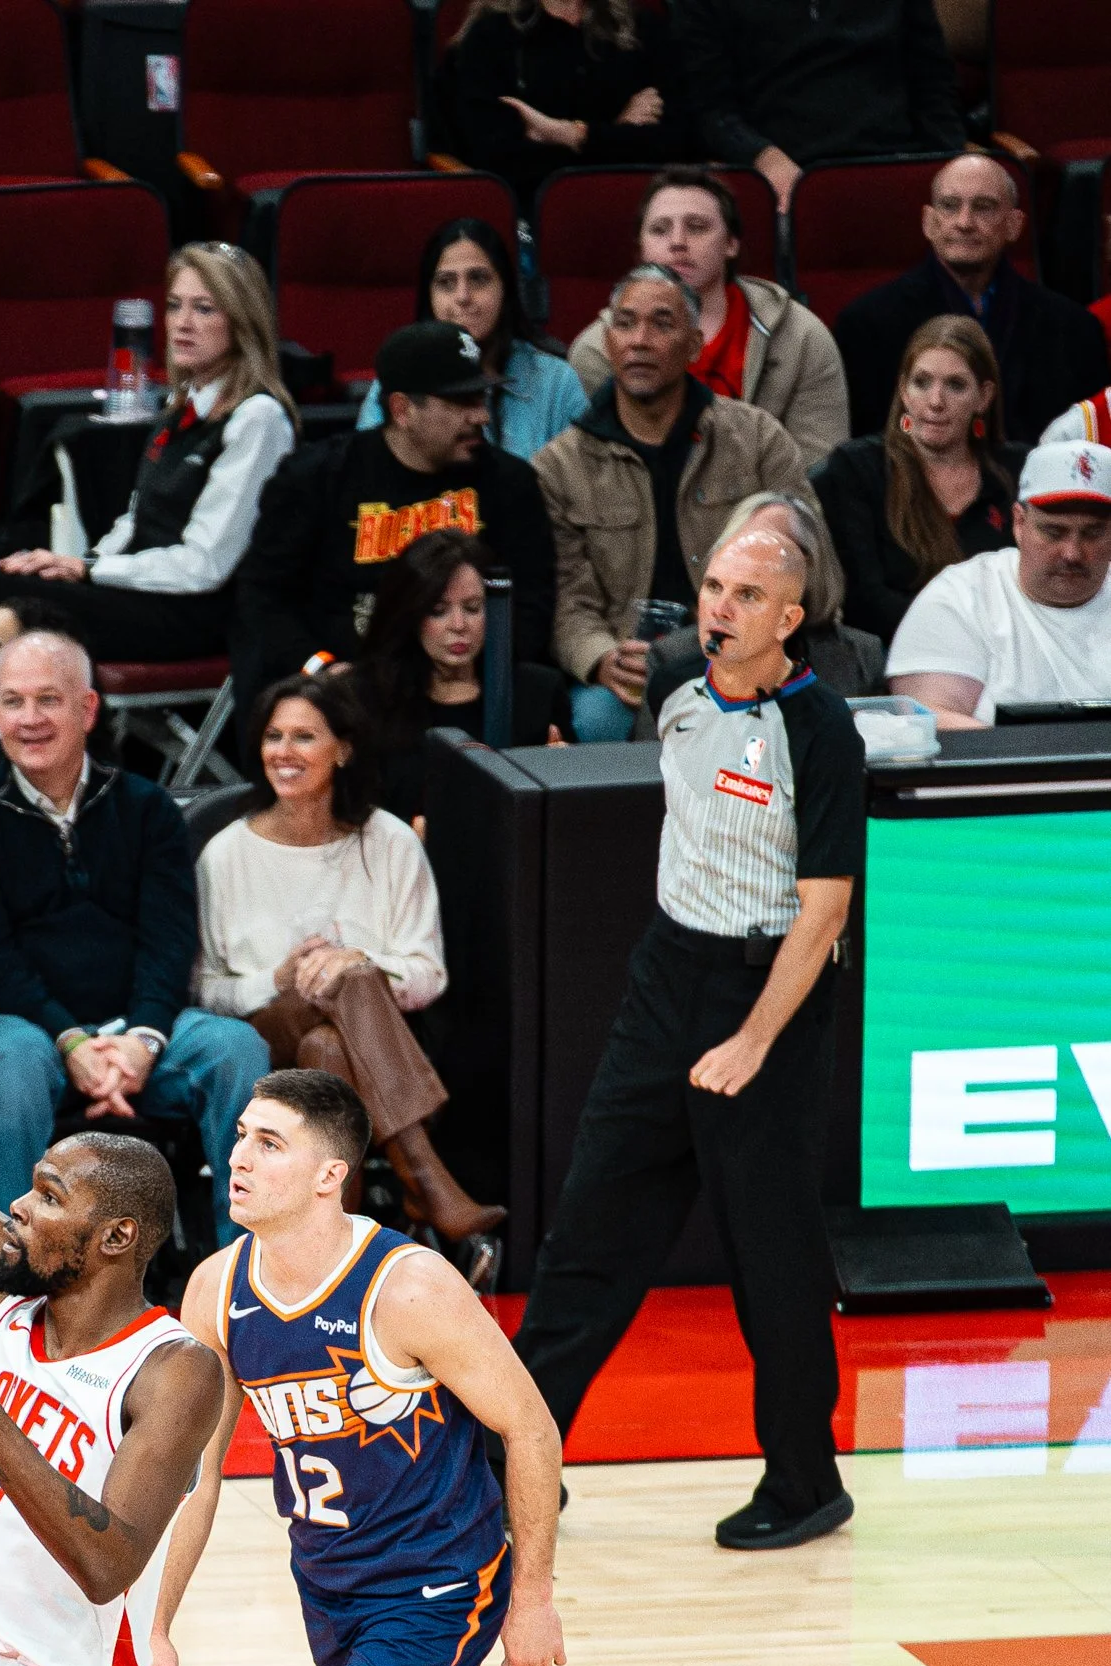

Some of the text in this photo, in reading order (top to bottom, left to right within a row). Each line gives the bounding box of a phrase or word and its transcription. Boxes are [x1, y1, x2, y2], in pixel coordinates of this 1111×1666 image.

[716, 772, 770, 802] Emirates
[314, 1316, 357, 1335] PayPal
[278, 1447, 349, 1528] 12
